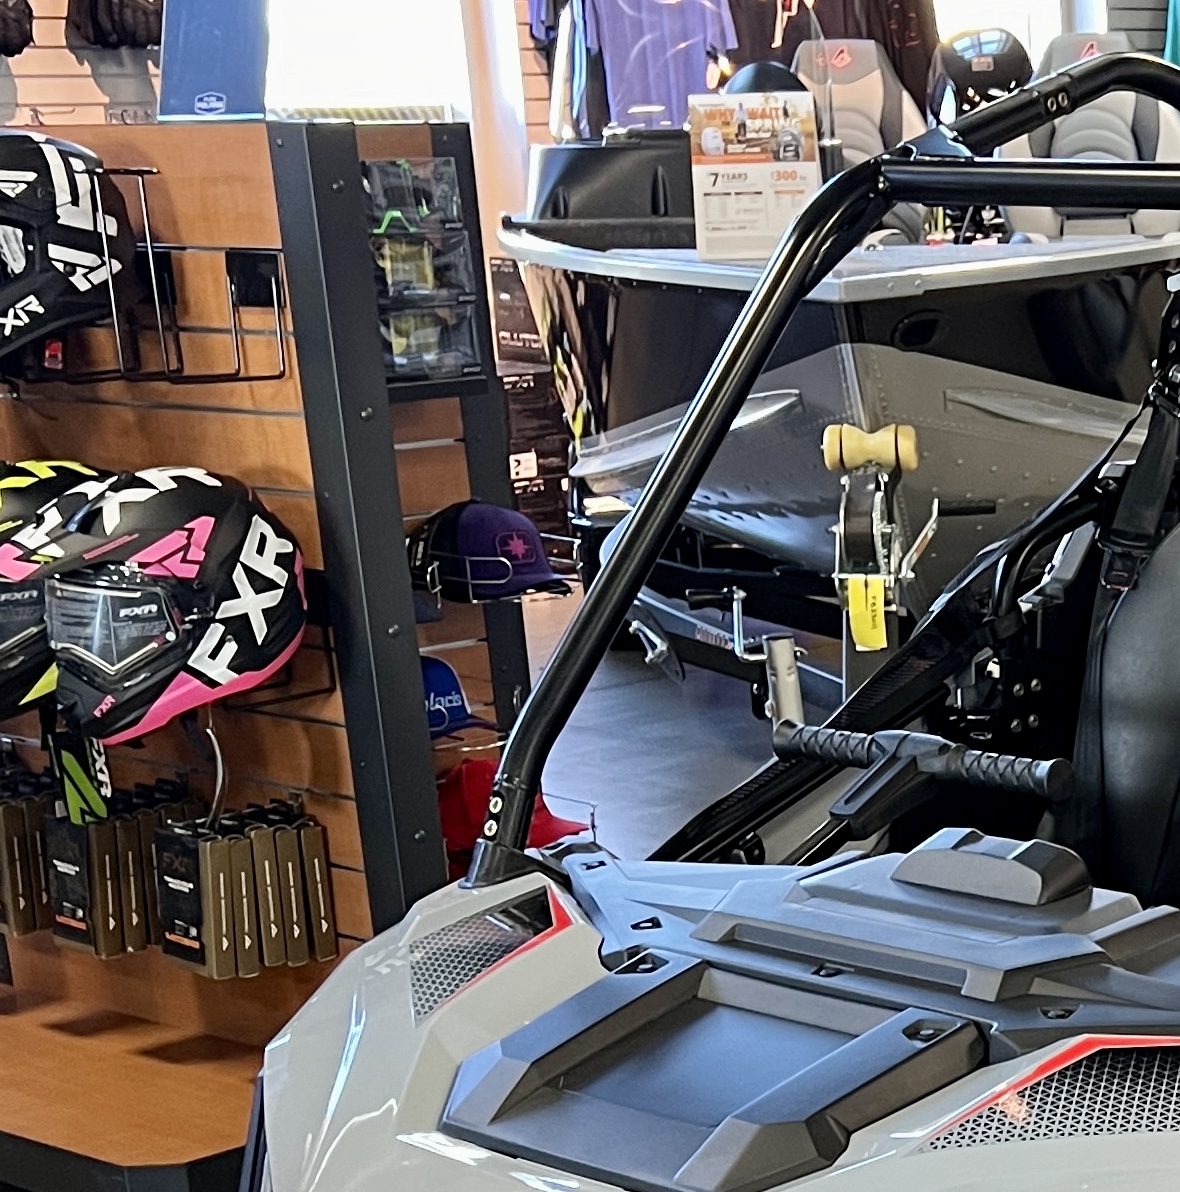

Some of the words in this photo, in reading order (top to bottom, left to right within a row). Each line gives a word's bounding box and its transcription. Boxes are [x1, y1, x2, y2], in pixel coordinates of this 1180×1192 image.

[709, 172, 719, 187] 7
[0, 295, 45, 337] XR
[187, 514, 293, 685] FXR
[118, 603, 158, 618] FXR
[425, 691, 463, 711] laris
